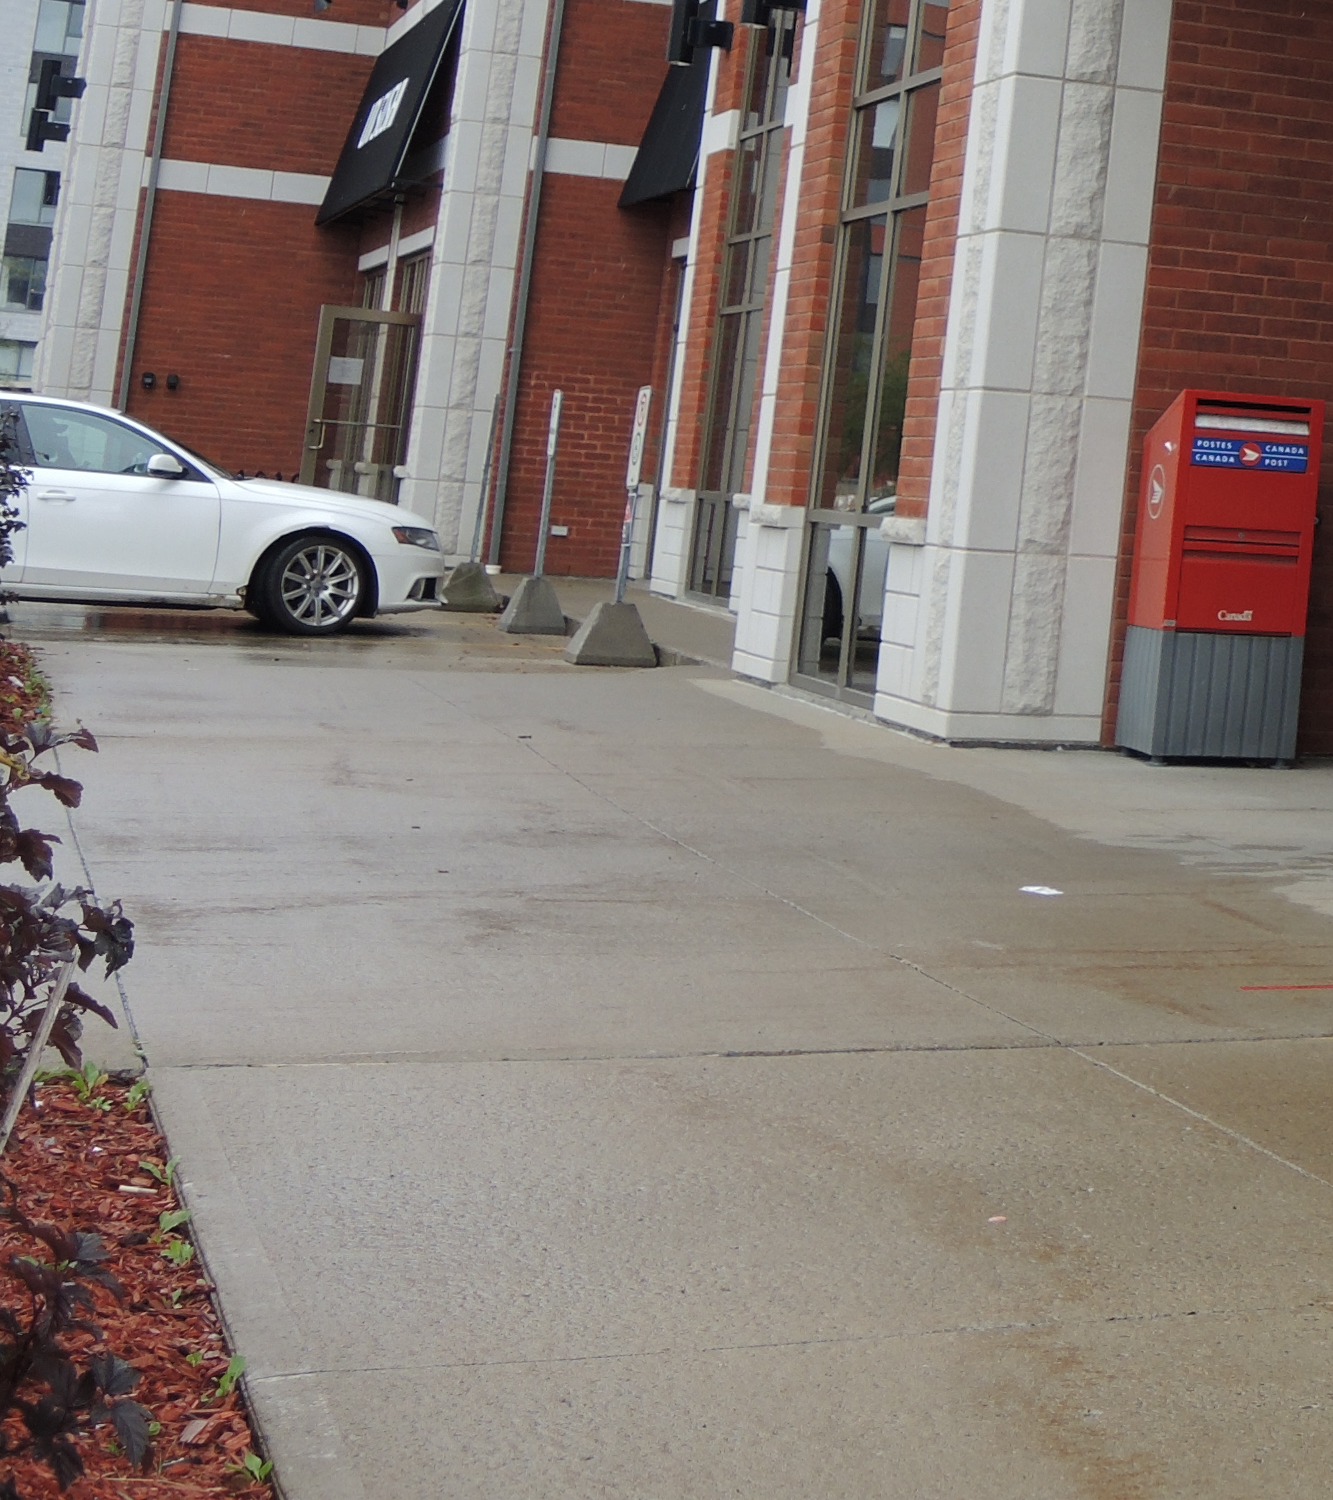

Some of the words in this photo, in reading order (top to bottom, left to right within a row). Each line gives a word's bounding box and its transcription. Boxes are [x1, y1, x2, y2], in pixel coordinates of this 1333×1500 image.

[1197, 440, 1232, 449] POSTES
[1265, 445, 1304, 455] CANADA
[1195, 453, 1235, 464] CANADA
[1264, 458, 1288, 467] POST
